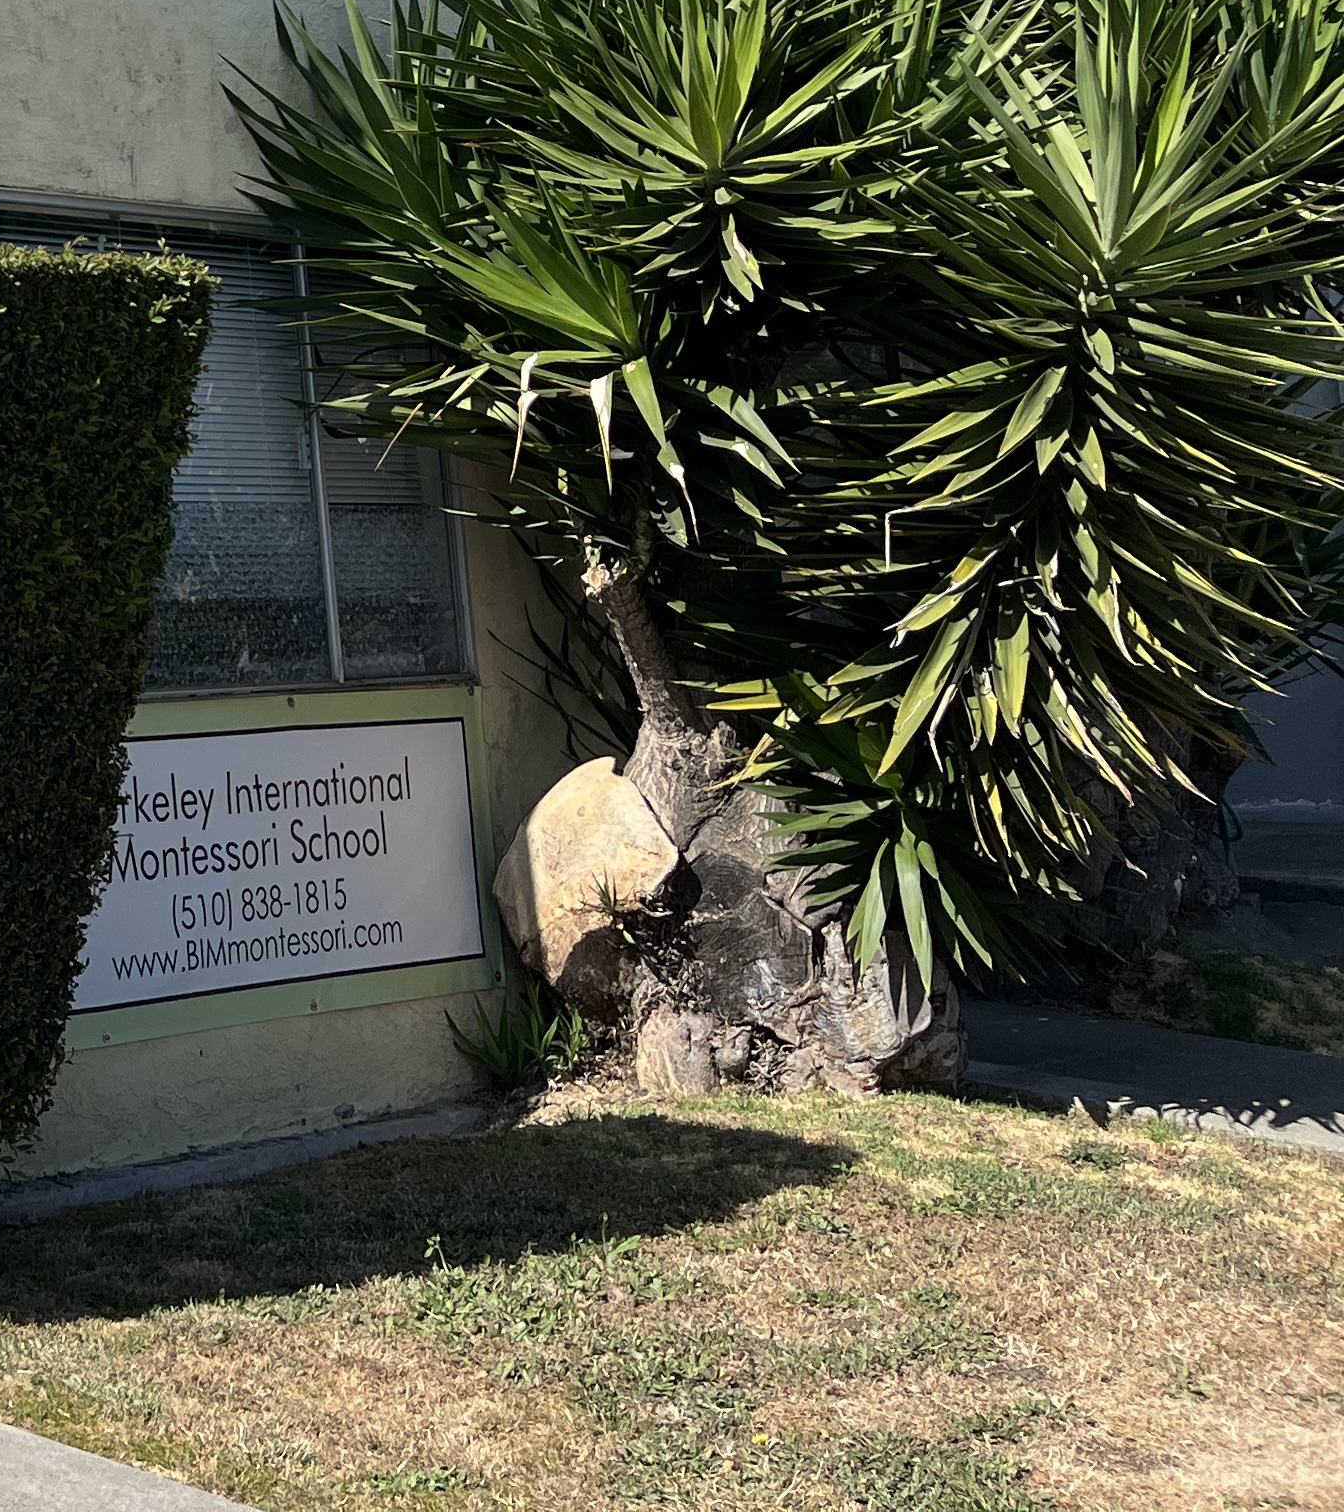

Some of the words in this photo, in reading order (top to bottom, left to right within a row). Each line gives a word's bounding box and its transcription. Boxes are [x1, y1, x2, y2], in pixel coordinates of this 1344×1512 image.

[226, 755, 411, 814] International
[109, 822, 278, 882] Montessori
[290, 810, 388, 864] School
[172, 888, 232, 938] (510)
[241, 877, 347, 922] 838-1815
[112, 919, 403, 980] www.BIMmontessori.com
